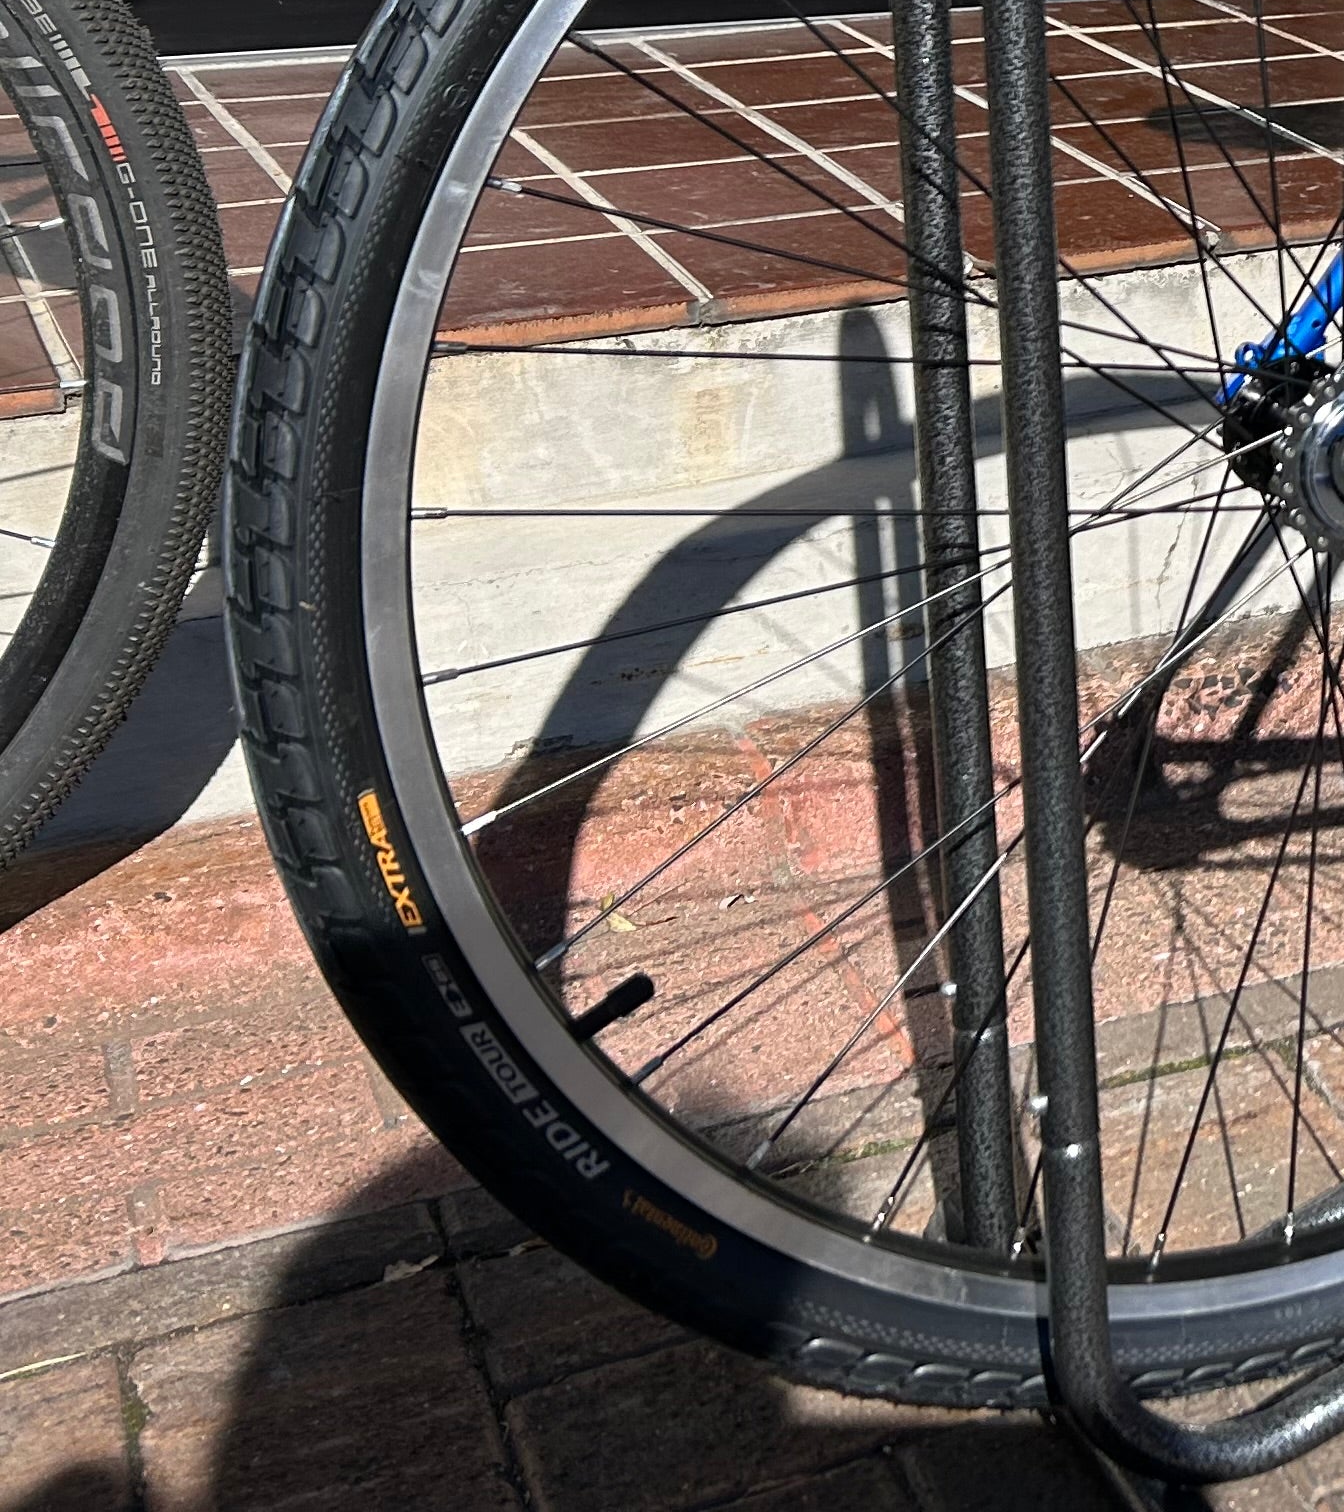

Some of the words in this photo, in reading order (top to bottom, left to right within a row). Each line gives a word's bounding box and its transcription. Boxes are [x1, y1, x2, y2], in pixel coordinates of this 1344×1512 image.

[370, 831, 425, 929] EXTRA
[470, 1025, 532, 1102] TOUR
[522, 1105, 611, 1181] RIDE
